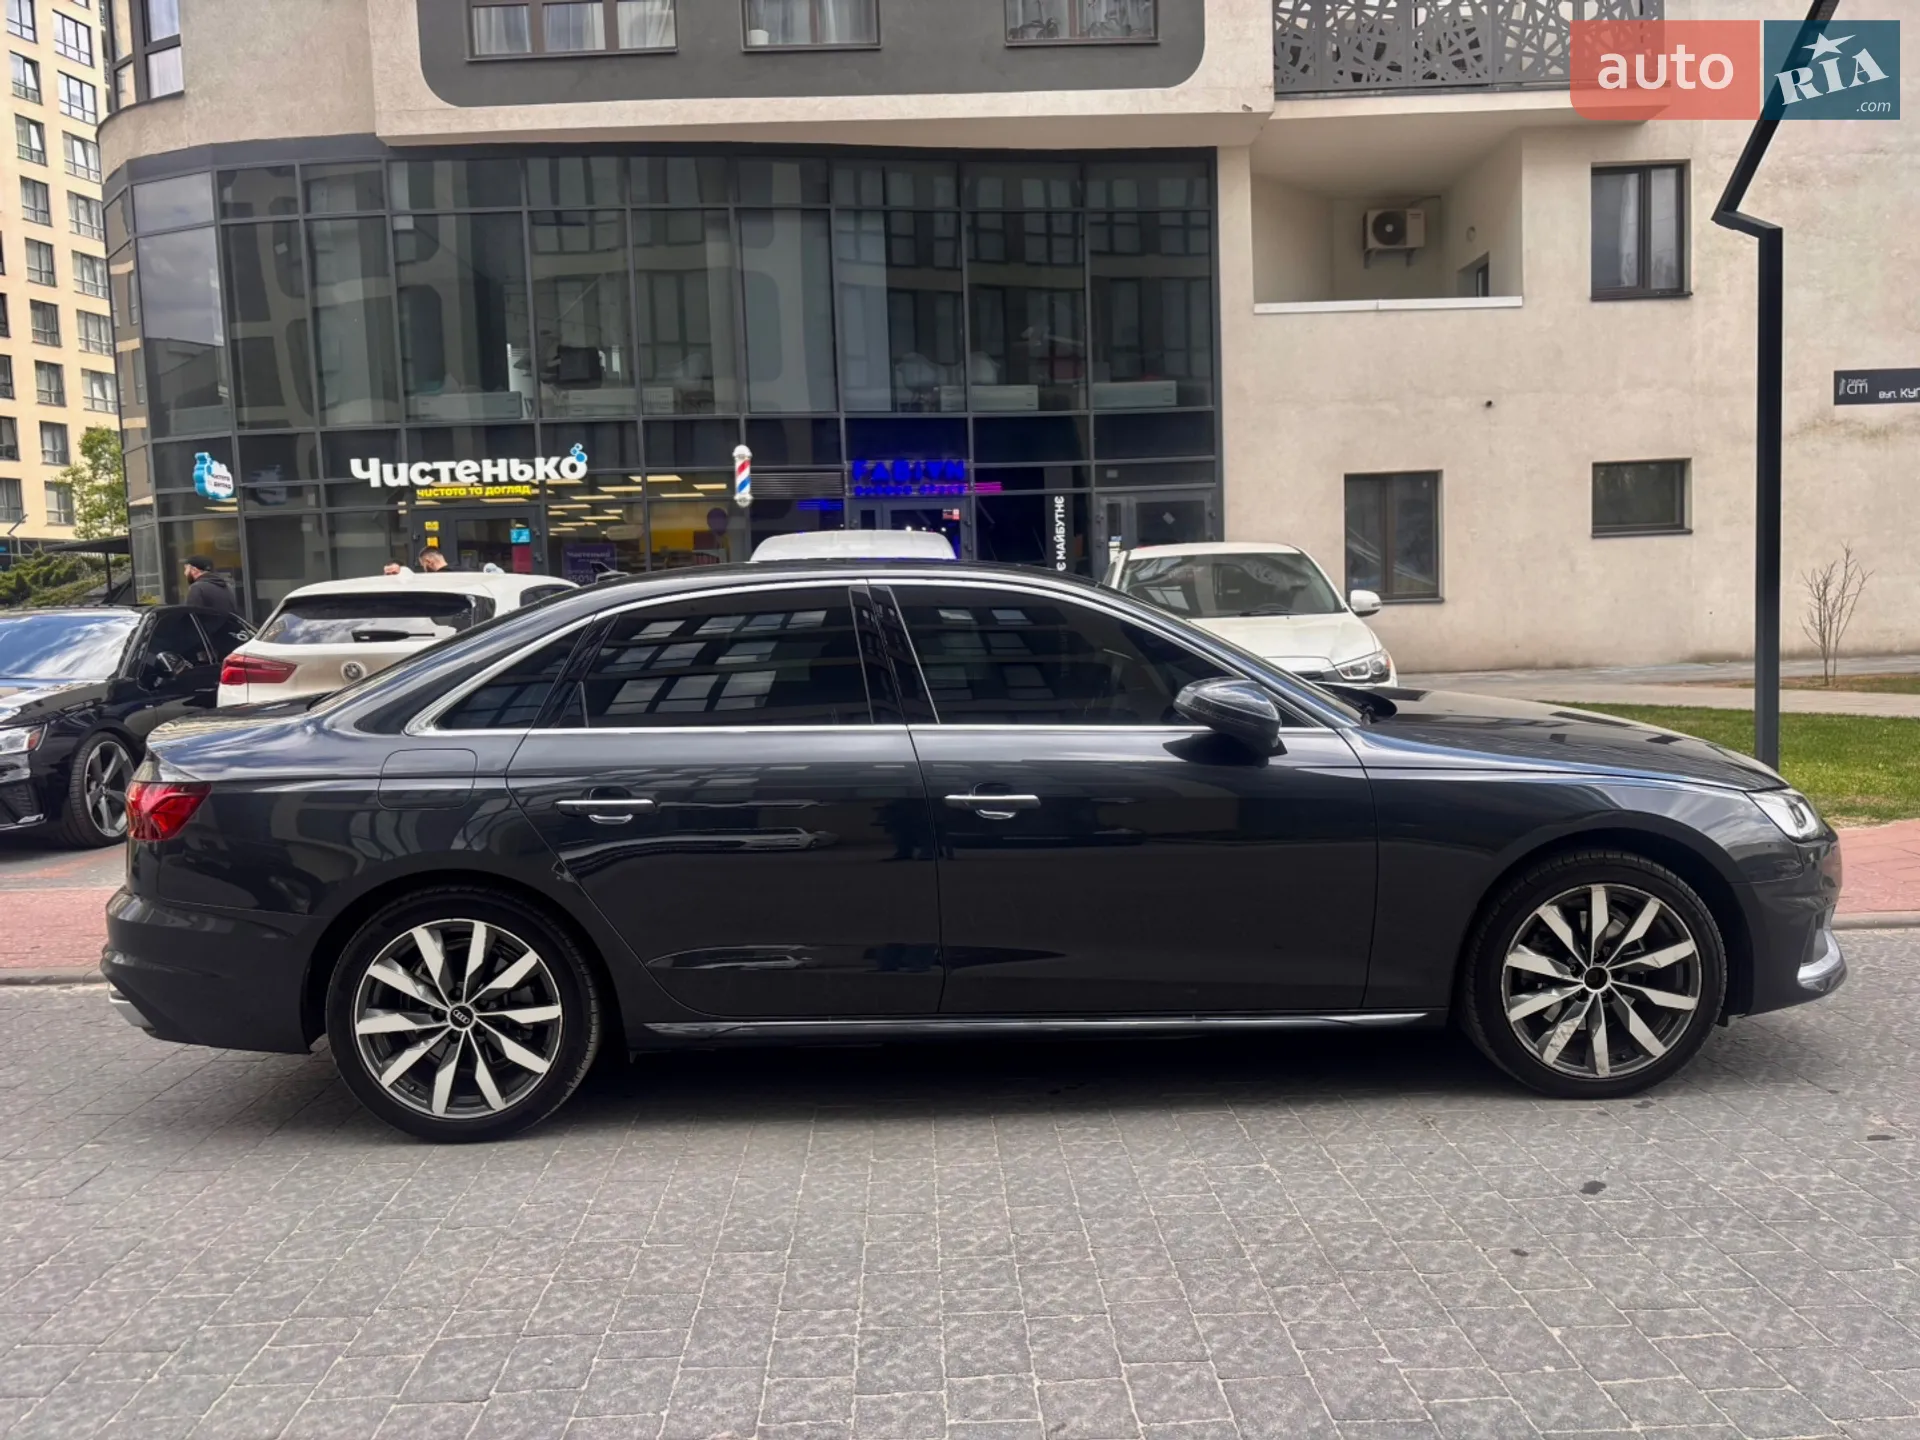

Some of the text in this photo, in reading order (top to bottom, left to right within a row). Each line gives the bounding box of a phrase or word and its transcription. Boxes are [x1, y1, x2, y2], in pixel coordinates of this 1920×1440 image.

[350, 455, 588, 488] Чистенько
[416, 484, 532, 498] чистота та догляд
[1053, 495, 1067, 560] МАЙБУТНЄ
